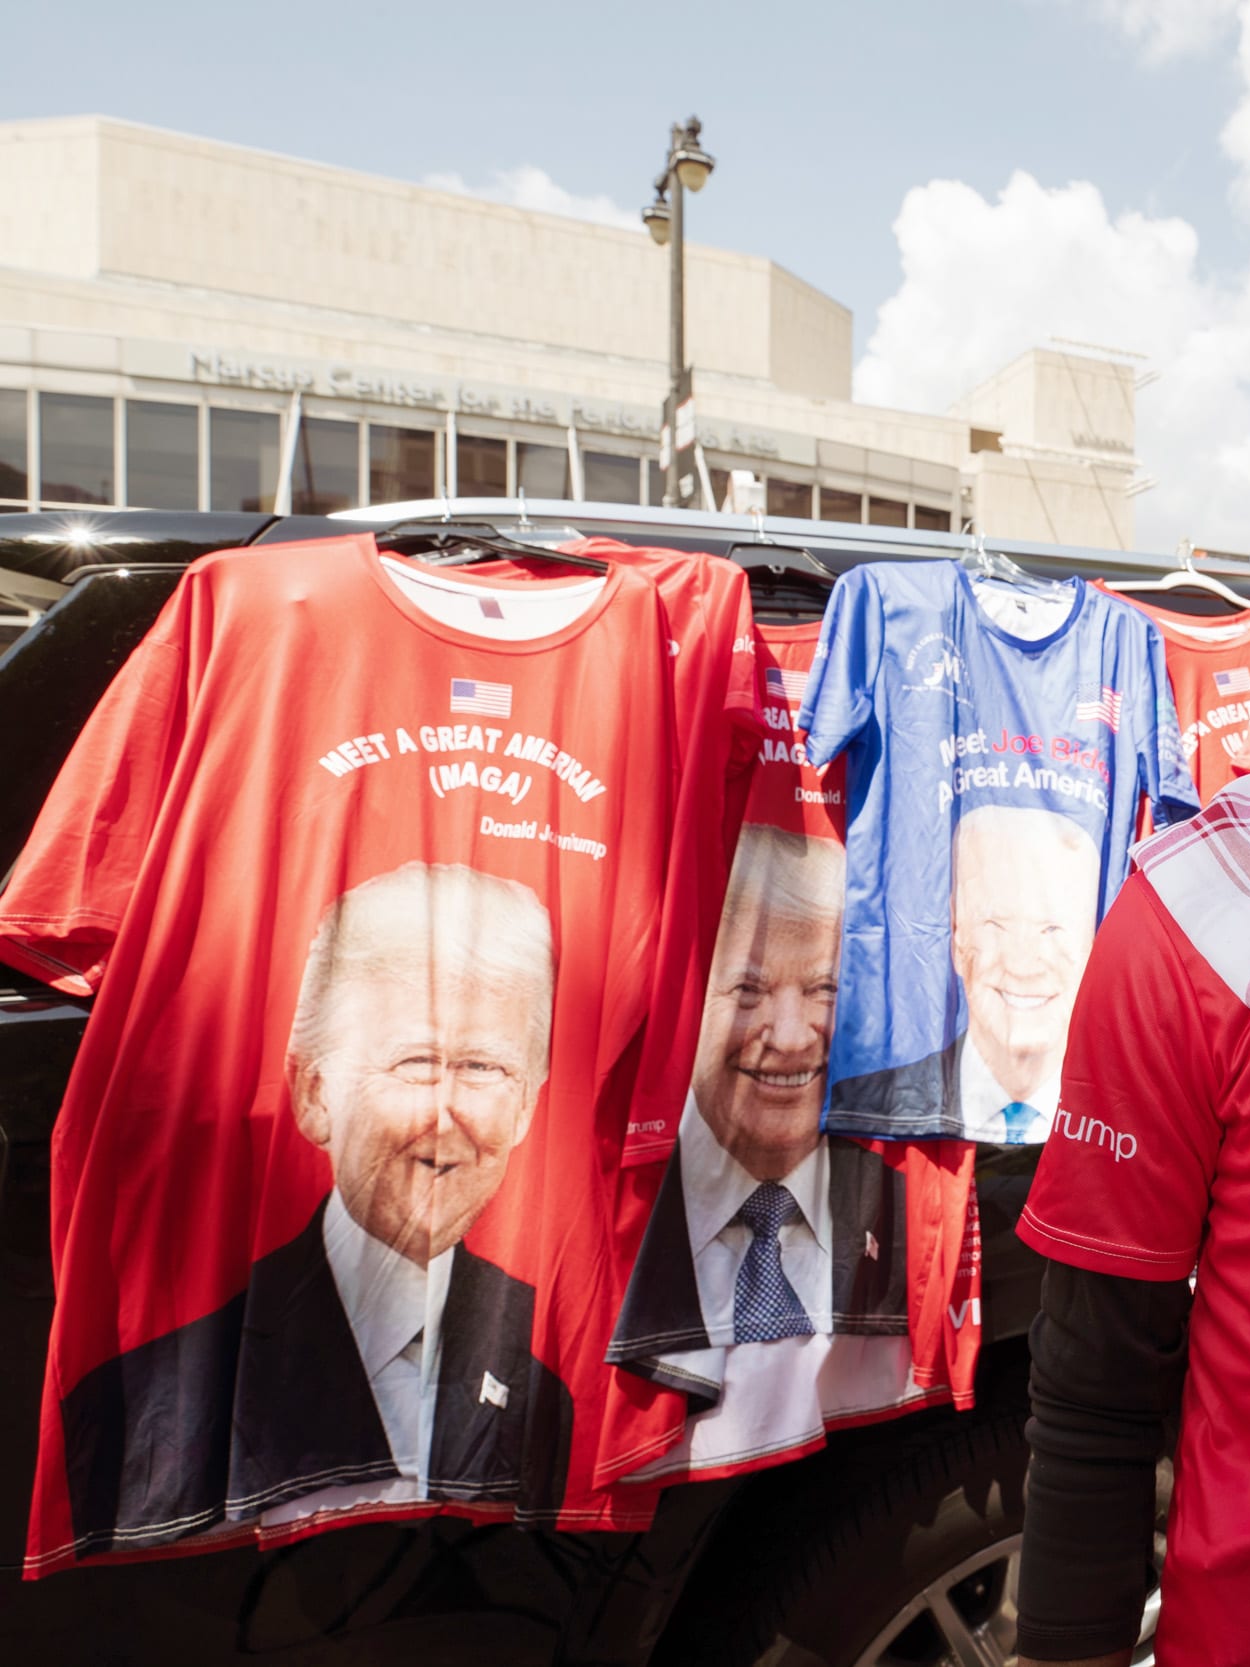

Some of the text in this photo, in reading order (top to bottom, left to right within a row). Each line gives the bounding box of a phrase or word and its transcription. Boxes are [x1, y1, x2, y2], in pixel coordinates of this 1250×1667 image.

[327, 365, 443, 404] Center
[318, 733, 391, 778] MEET
[396, 728, 418, 754] A
[419, 725, 503, 753] GREAT
[992, 728, 1044, 755] Joe
[429, 761, 532, 806] (MAGA)
[795, 787, 841, 804] Donald
[954, 761, 1010, 794] Great
[1014, 761, 1109, 816] Americ
[480, 816, 538, 839] Donald
[1055, 1098, 1137, 1162] rump
